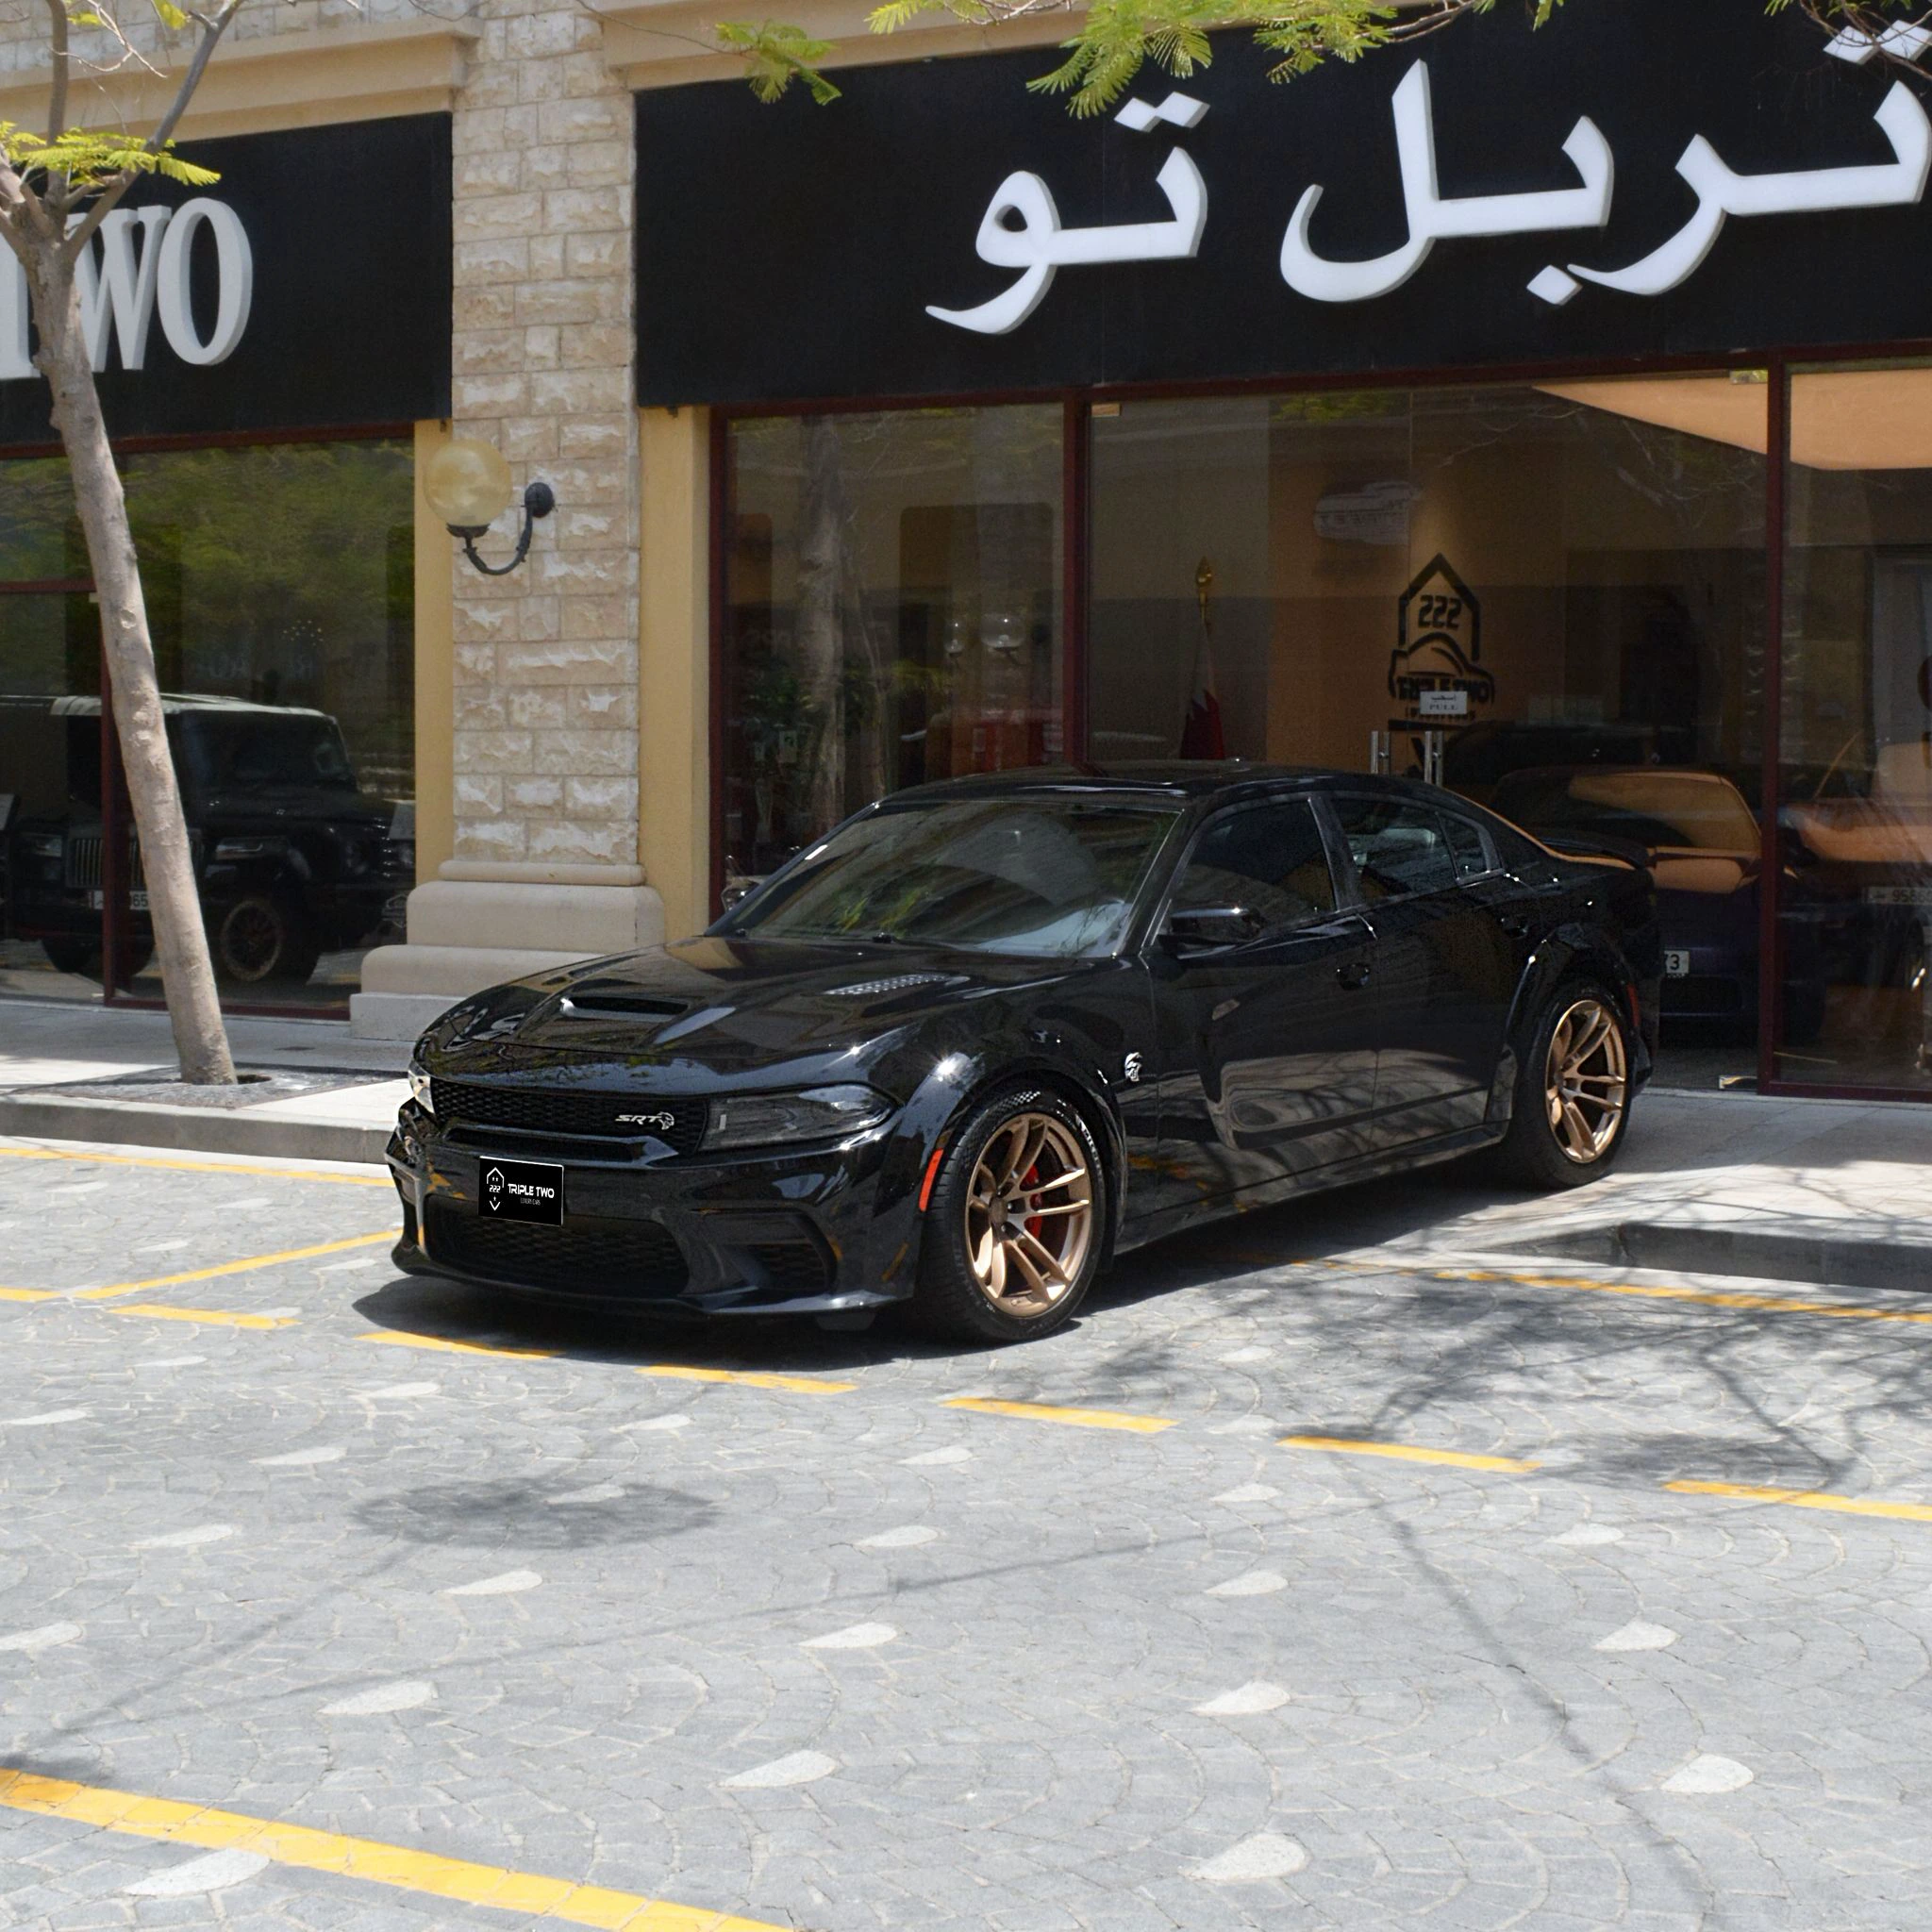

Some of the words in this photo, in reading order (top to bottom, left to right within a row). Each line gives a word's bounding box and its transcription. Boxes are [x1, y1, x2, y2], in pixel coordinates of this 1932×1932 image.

[925, 91, 1211, 335] تو
[1418, 594, 1462, 629] 222
[614, 1114, 662, 1125] SRT
[489, 1184, 501, 1193] 222
[508, 1183, 534, 1196] TRIPLE
[535, 1186, 555, 1199] TWO
